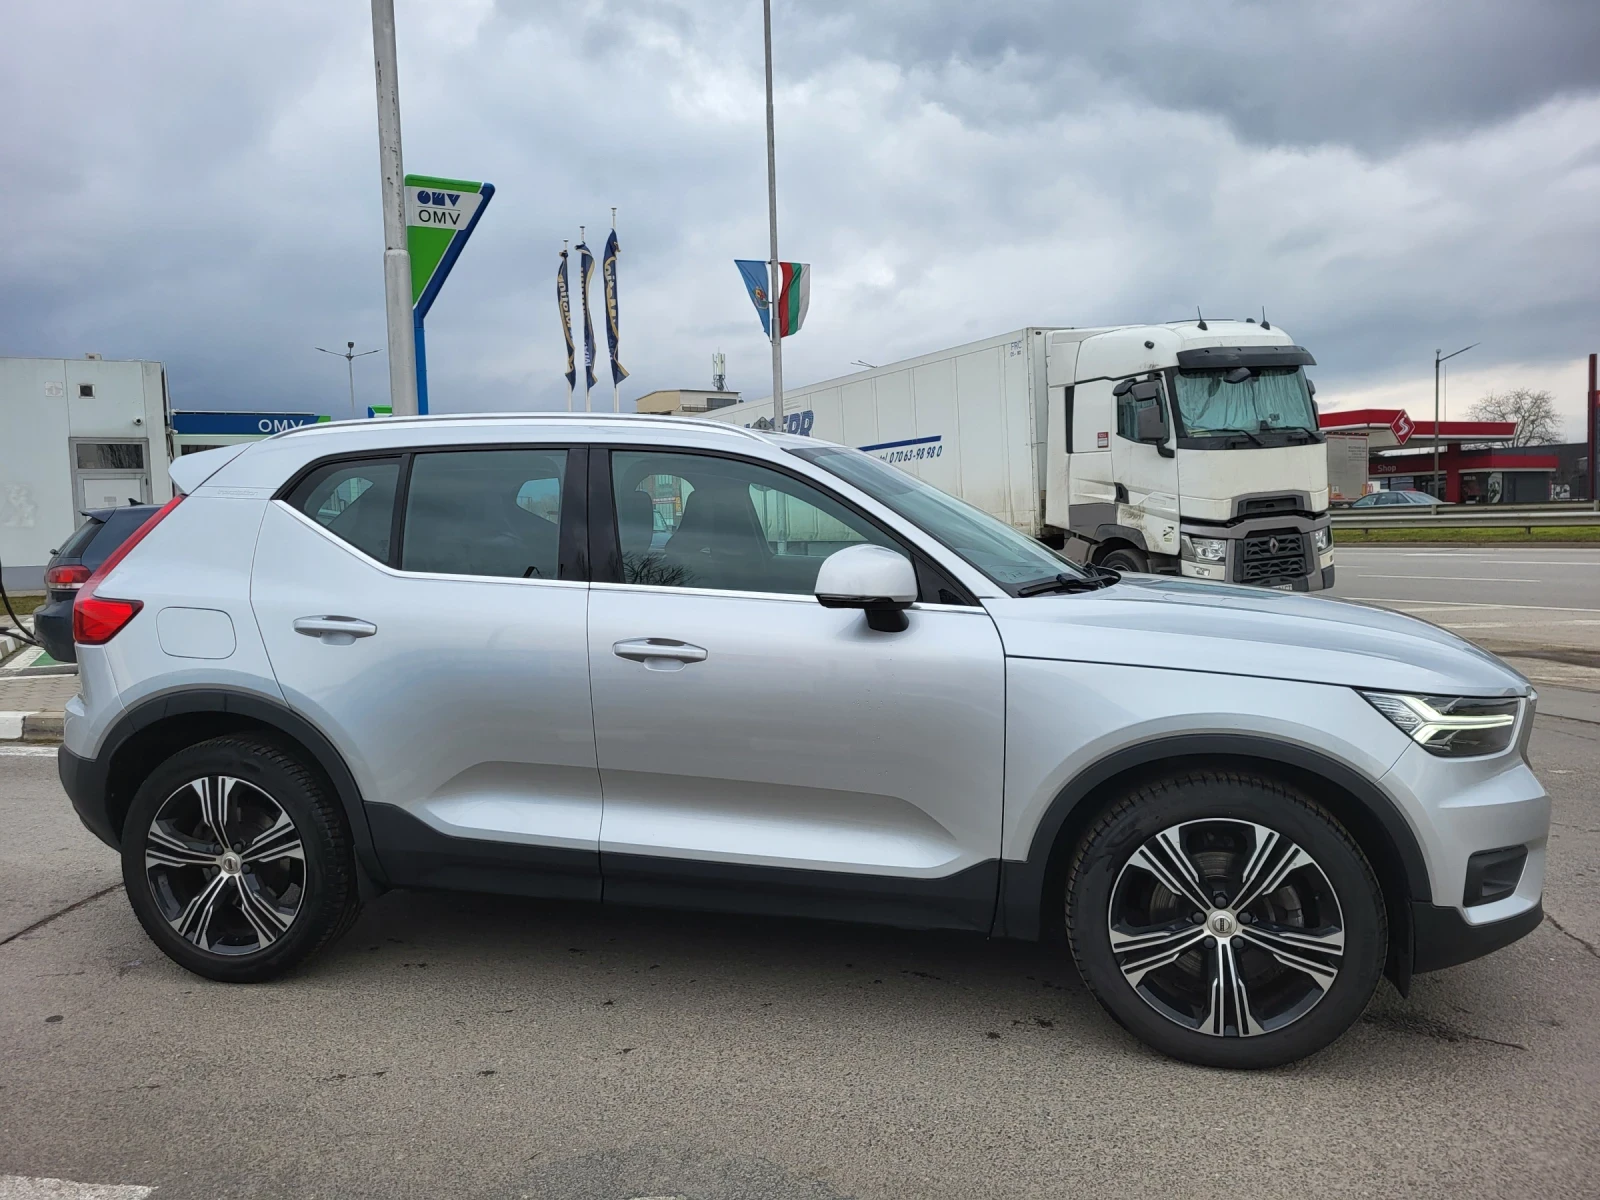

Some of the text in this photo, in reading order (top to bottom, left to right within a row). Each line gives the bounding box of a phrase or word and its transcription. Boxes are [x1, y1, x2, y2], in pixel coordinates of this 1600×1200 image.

[418, 209, 460, 225] OMV
[258, 419, 304, 432] OMV
[1377, 464, 1397, 473] Shop
